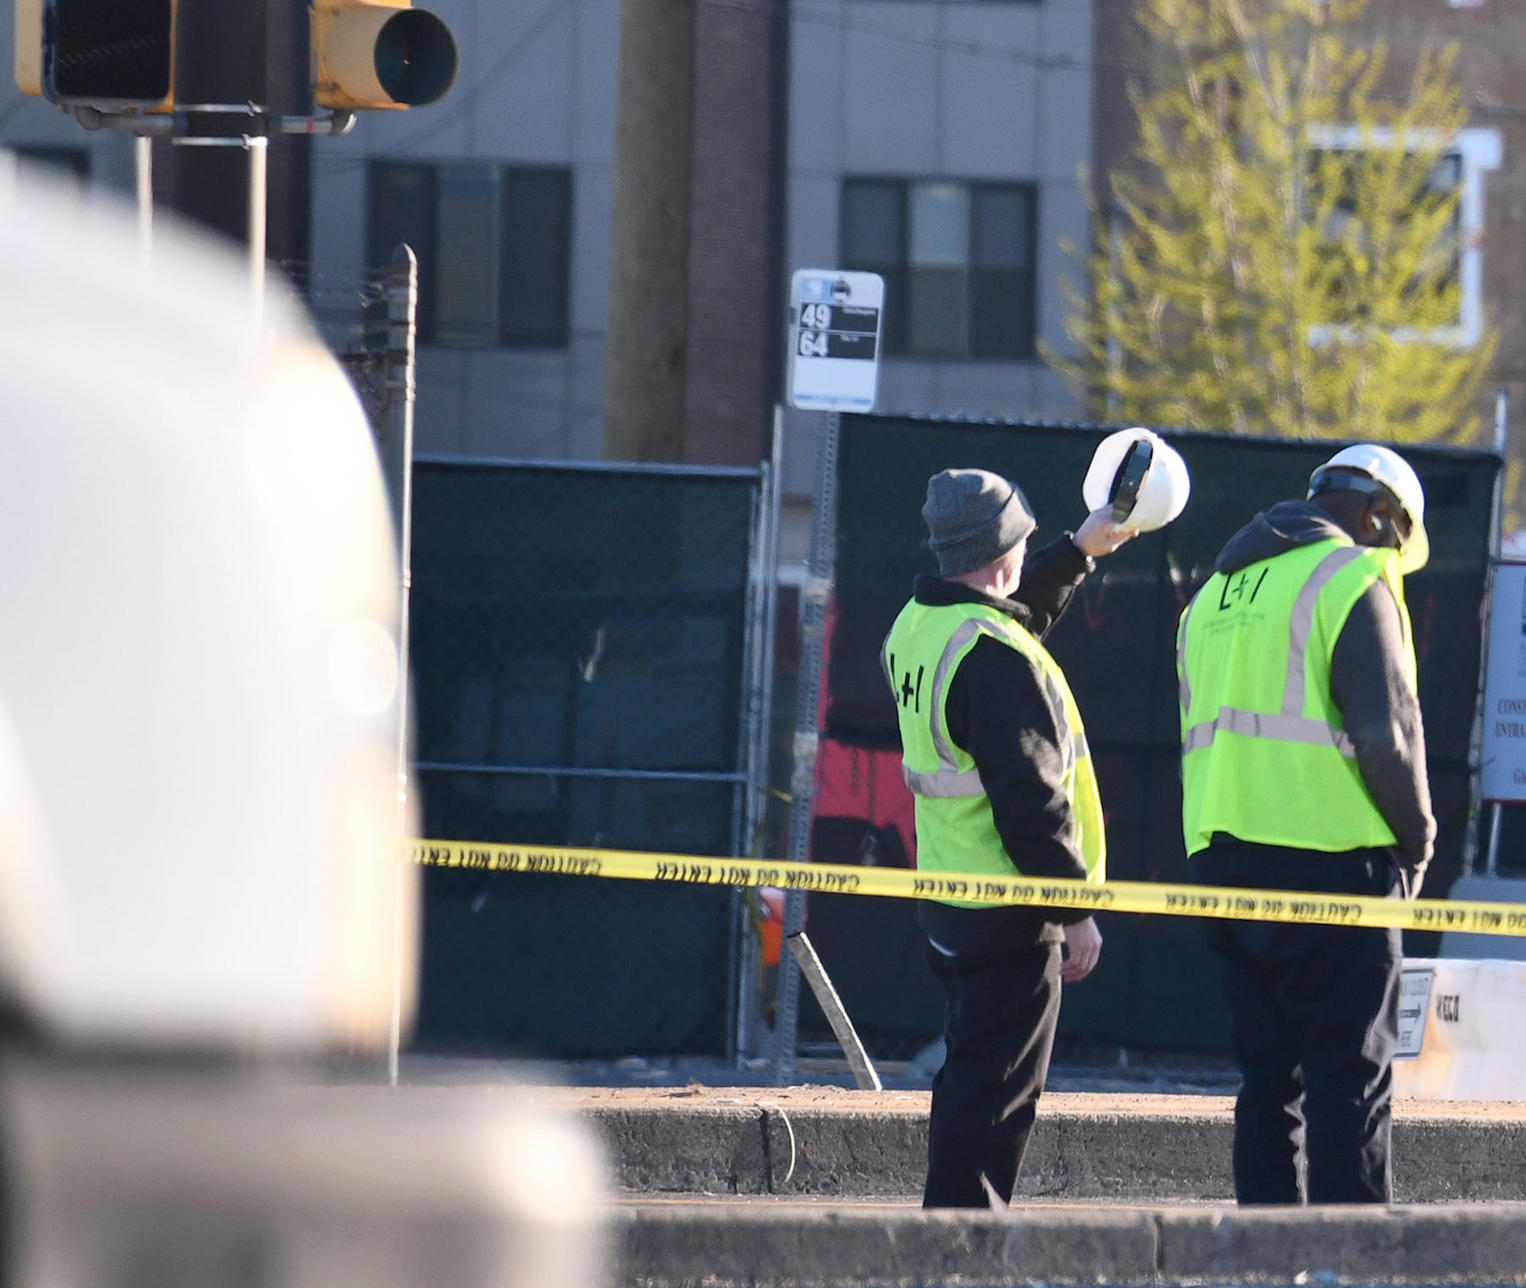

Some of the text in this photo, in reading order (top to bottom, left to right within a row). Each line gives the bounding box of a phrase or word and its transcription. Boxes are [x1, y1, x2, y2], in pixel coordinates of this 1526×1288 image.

[801, 303, 832, 330] 49
[799, 330, 828, 356] 64
[460, 848, 491, 869] NOT
[498, 851, 520, 871] DO
[527, 853, 602, 878] CAUTION
[656, 861, 860, 894] CAUTION DO NOT ENTER
[913, 877, 1115, 909] CAUTION DO NOT ENTER
[1165, 892, 1362, 924] CAUTION DO NOT ENTER
[1412, 907, 1465, 929] ENTER
[1472, 910, 1502, 931] NOT
